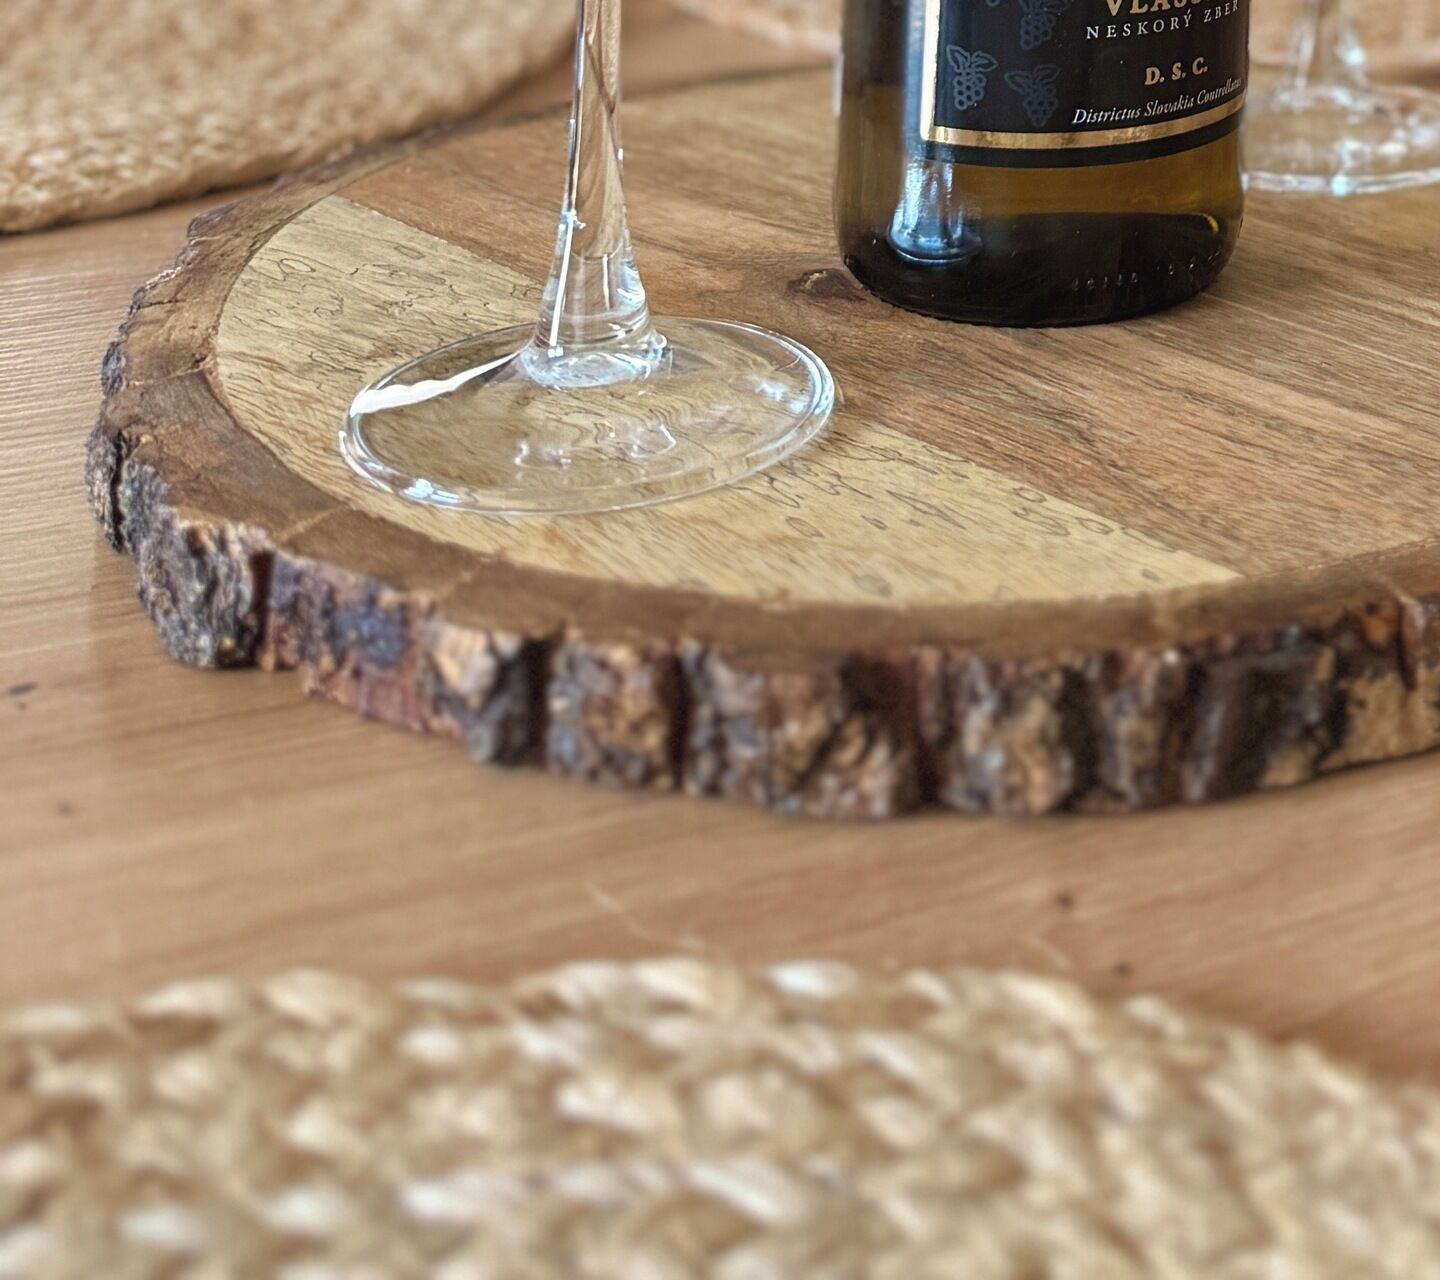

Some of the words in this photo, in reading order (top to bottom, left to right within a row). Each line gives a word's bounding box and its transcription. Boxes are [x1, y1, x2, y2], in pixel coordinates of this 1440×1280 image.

[1086, 8, 1192, 40] NESKORÝ
[1203, 0, 1239, 23] ZBER
[1144, 67, 1165, 85] D.
[1171, 62, 1186, 80] S.
[1192, 57, 1208, 75] C.
[1071, 108, 1141, 125] Districtus
[1144, 95, 1194, 117] Slovakia
